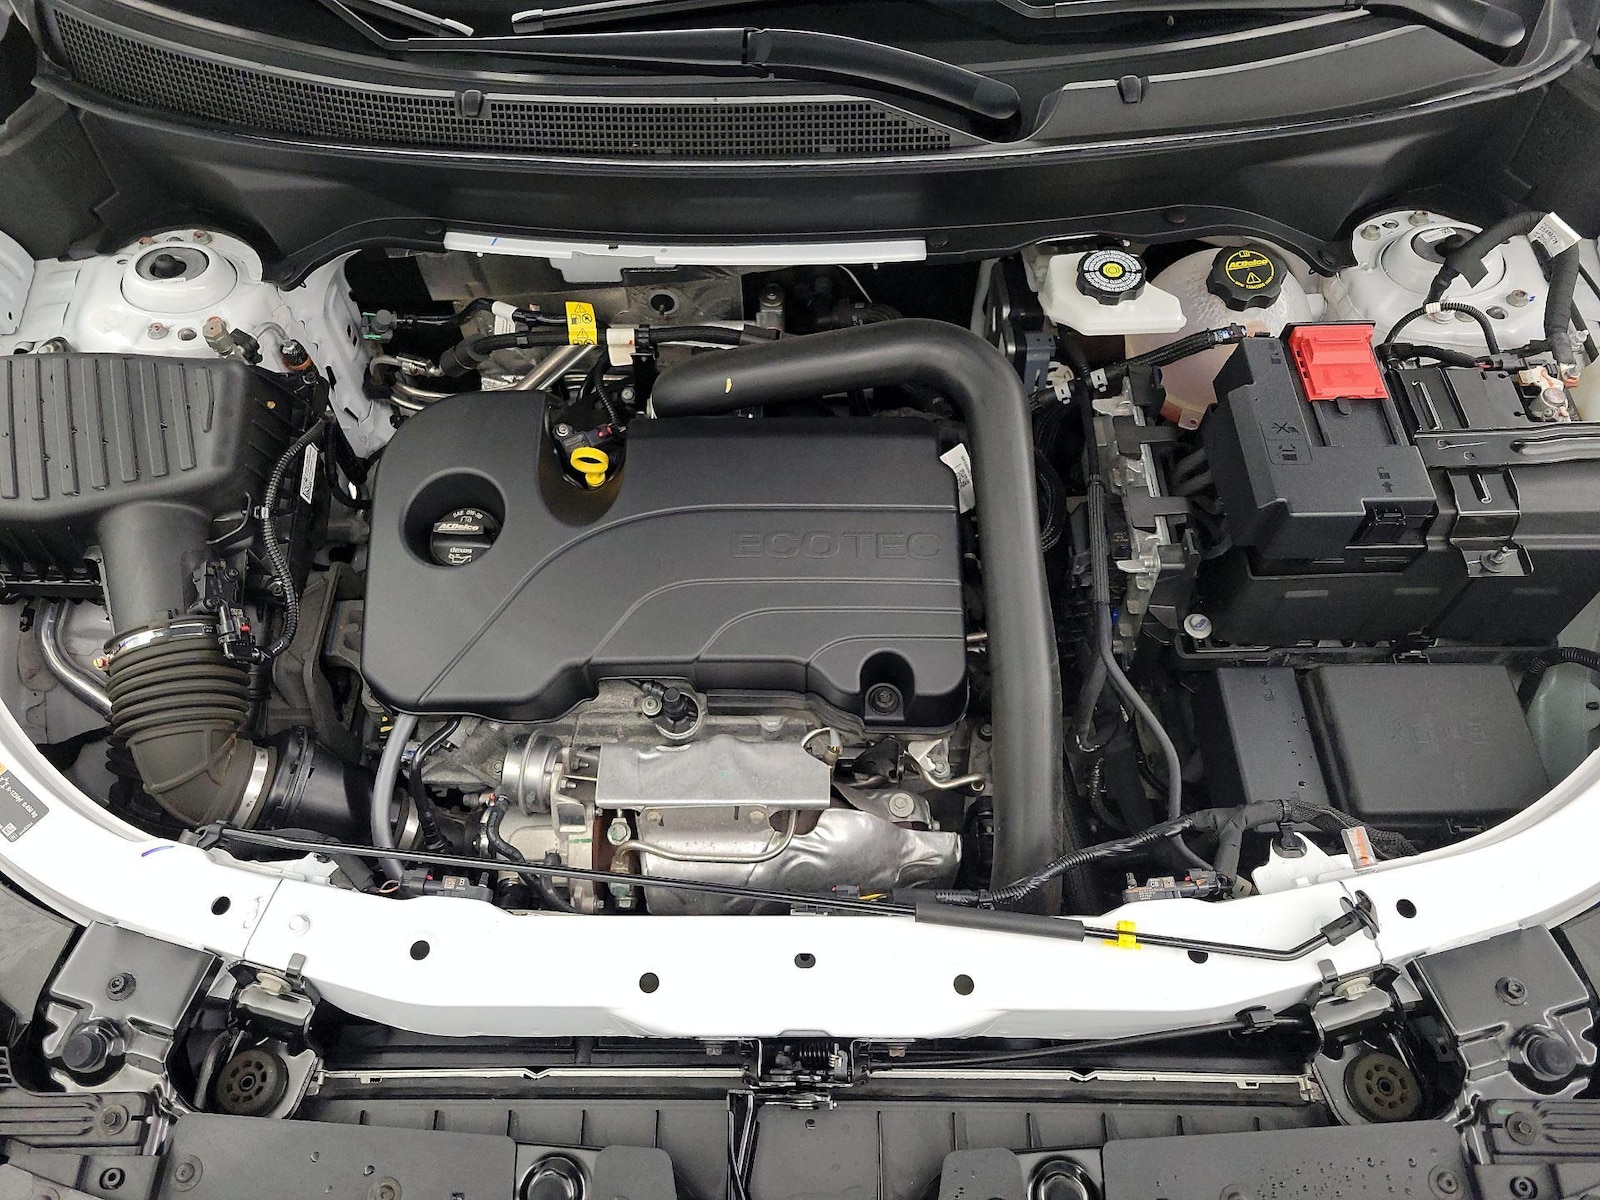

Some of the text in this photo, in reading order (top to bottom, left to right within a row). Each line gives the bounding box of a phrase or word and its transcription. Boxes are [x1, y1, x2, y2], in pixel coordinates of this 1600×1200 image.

[437, 523, 480, 532] ACDelco
[731, 529, 944, 560] ECOTEC
[449, 546, 473, 554] dexos
